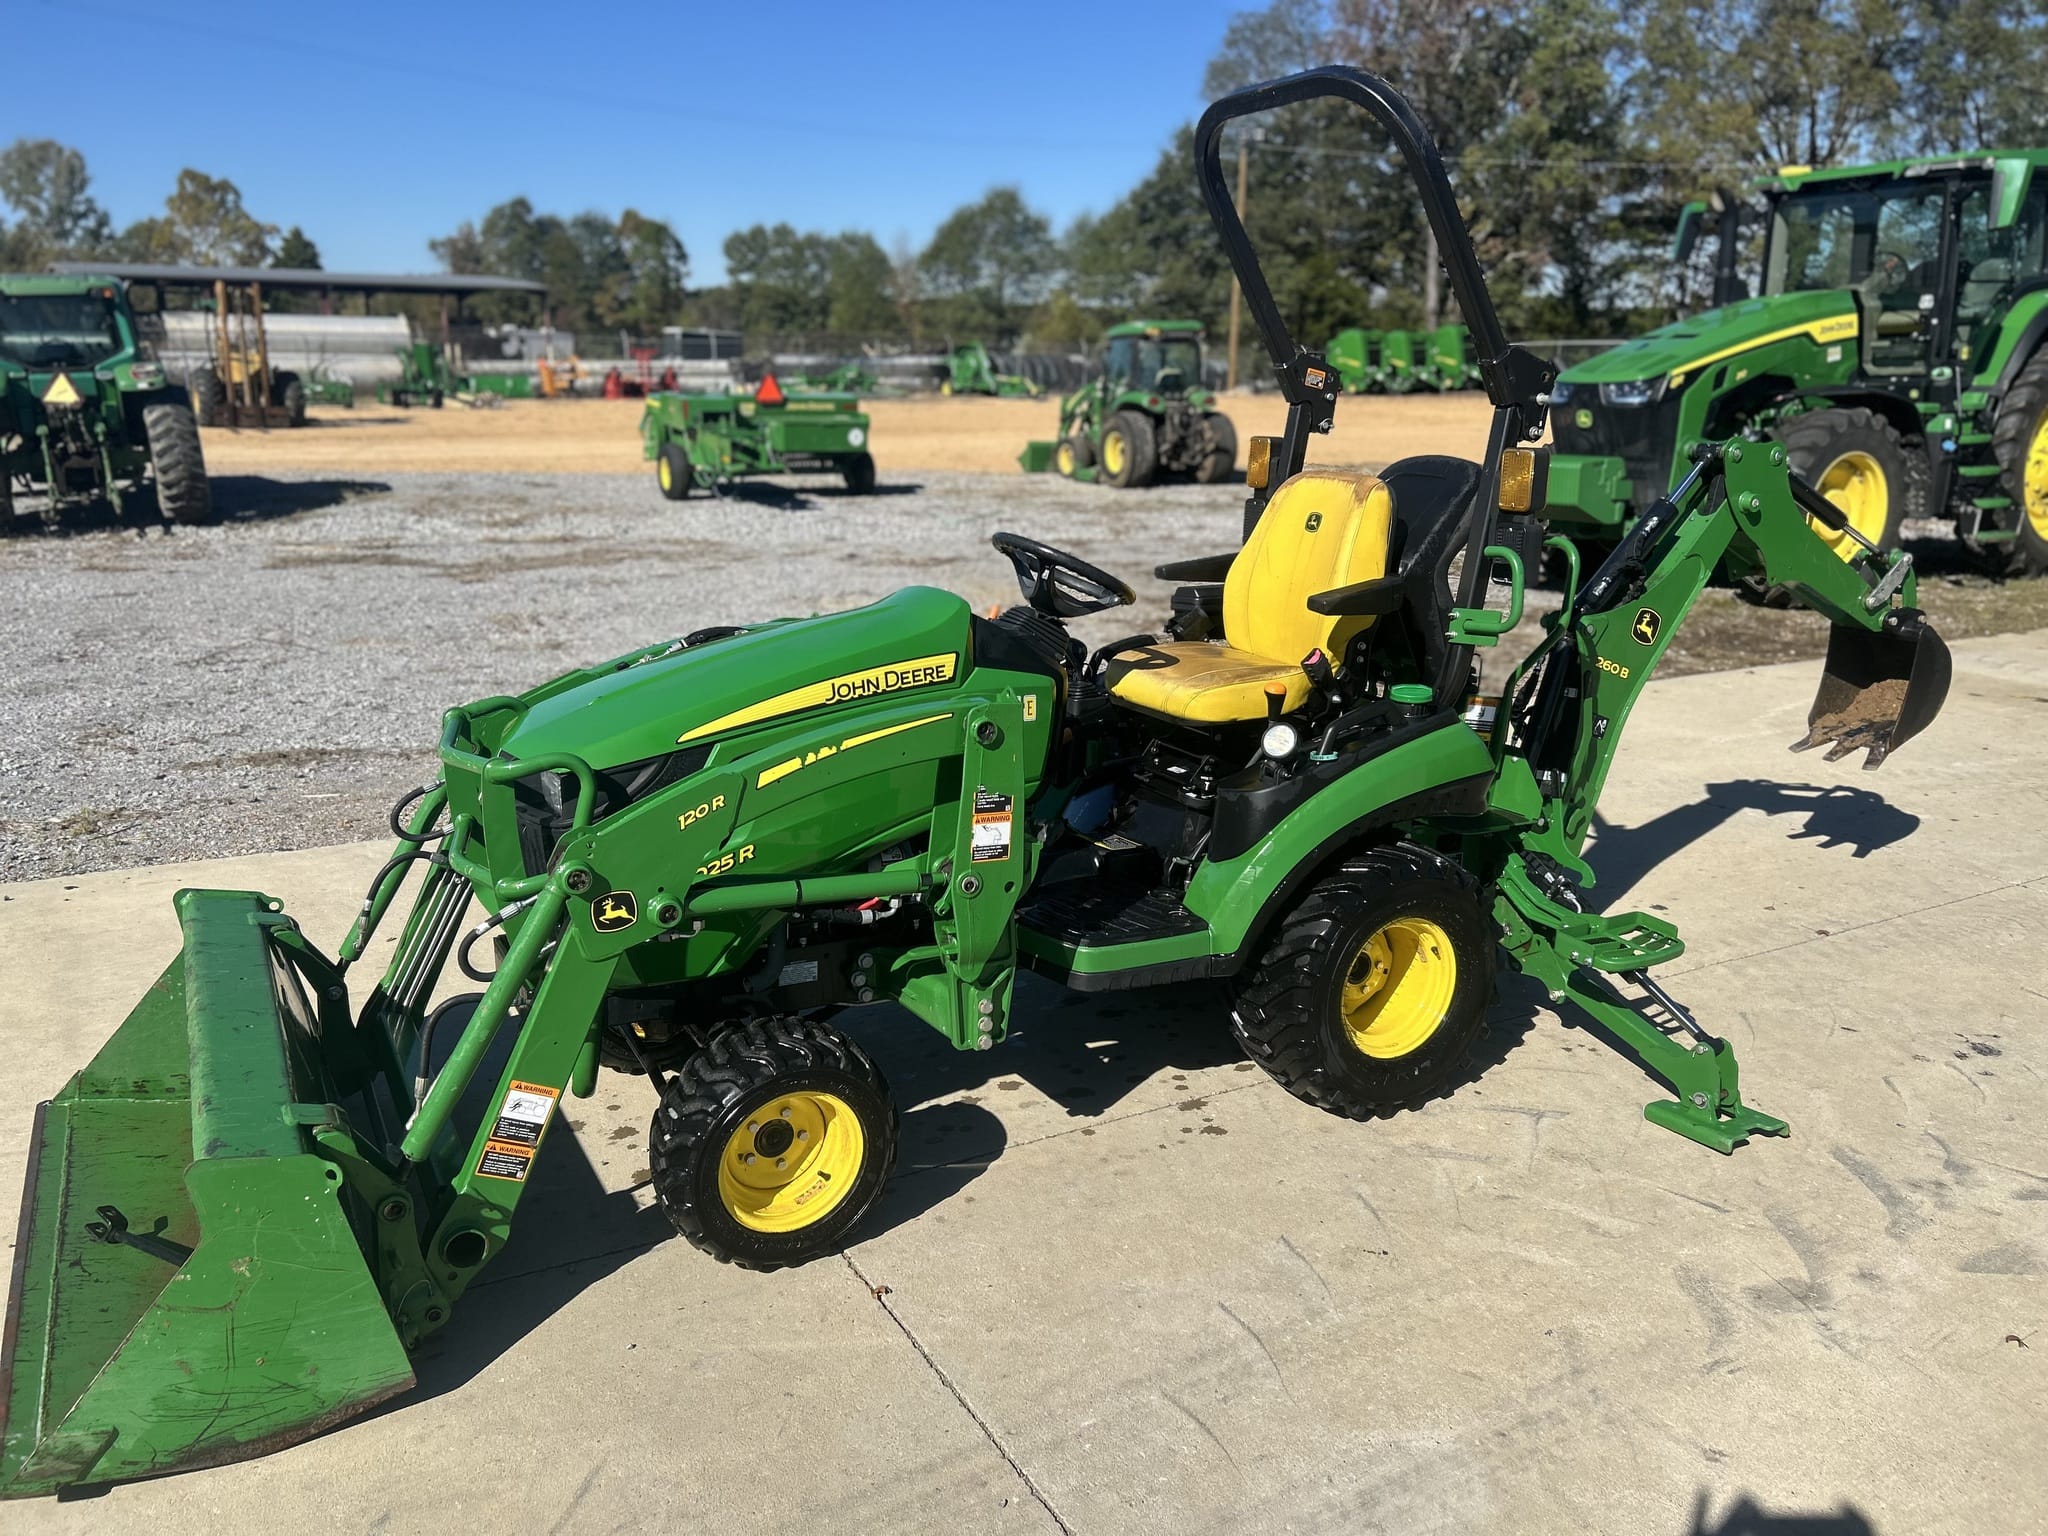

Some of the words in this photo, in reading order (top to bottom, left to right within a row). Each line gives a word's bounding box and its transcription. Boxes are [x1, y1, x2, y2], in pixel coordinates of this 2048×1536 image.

[1595, 656, 1620, 674] 260
[1620, 667, 1629, 679] B
[825, 676, 880, 702] JOHN
[884, 664, 946, 689] DEERE
[678, 803, 710, 830] 120
[712, 795, 725, 812] R
[981, 815, 1011, 823] WARNING
[739, 844, 754, 864] R
[523, 1084, 554, 1096] WARNING
[499, 1144, 531, 1156] WARNING
